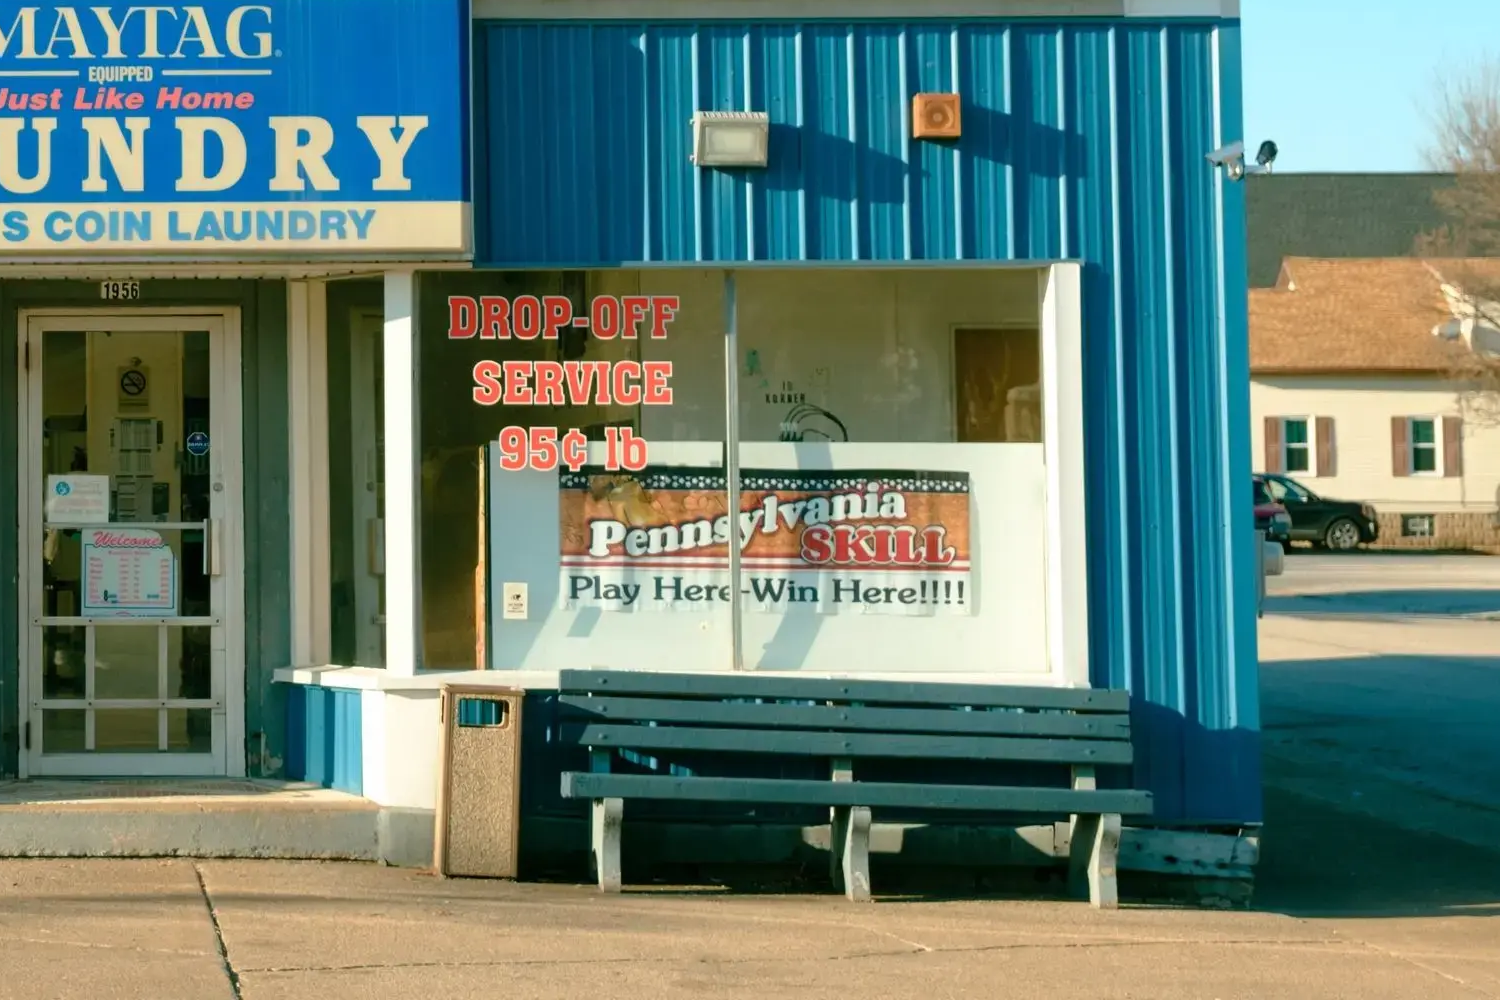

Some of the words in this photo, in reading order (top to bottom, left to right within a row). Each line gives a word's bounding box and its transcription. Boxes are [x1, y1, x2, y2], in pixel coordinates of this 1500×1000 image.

[88, 66, 153, 84] EQUIPPED
[73, 88, 144, 110] Like
[156, 87, 254, 109] Home
[43, 209, 152, 242] COIN
[167, 208, 377, 241] LAUNDRY
[103, 282, 139, 299] 1956
[448, 295, 679, 340] DROP-OFF
[473, 360, 673, 405] SERVICE
[499, 426, 588, 471] 95¢
[604, 426, 648, 471] lb
[588, 481, 907, 558] Pennsylvania
[92, 530, 162, 547] Welcome
[799, 523, 958, 567] SKILL
[569, 575, 641, 606] Play
[832, 577, 965, 605] Here!!!!
